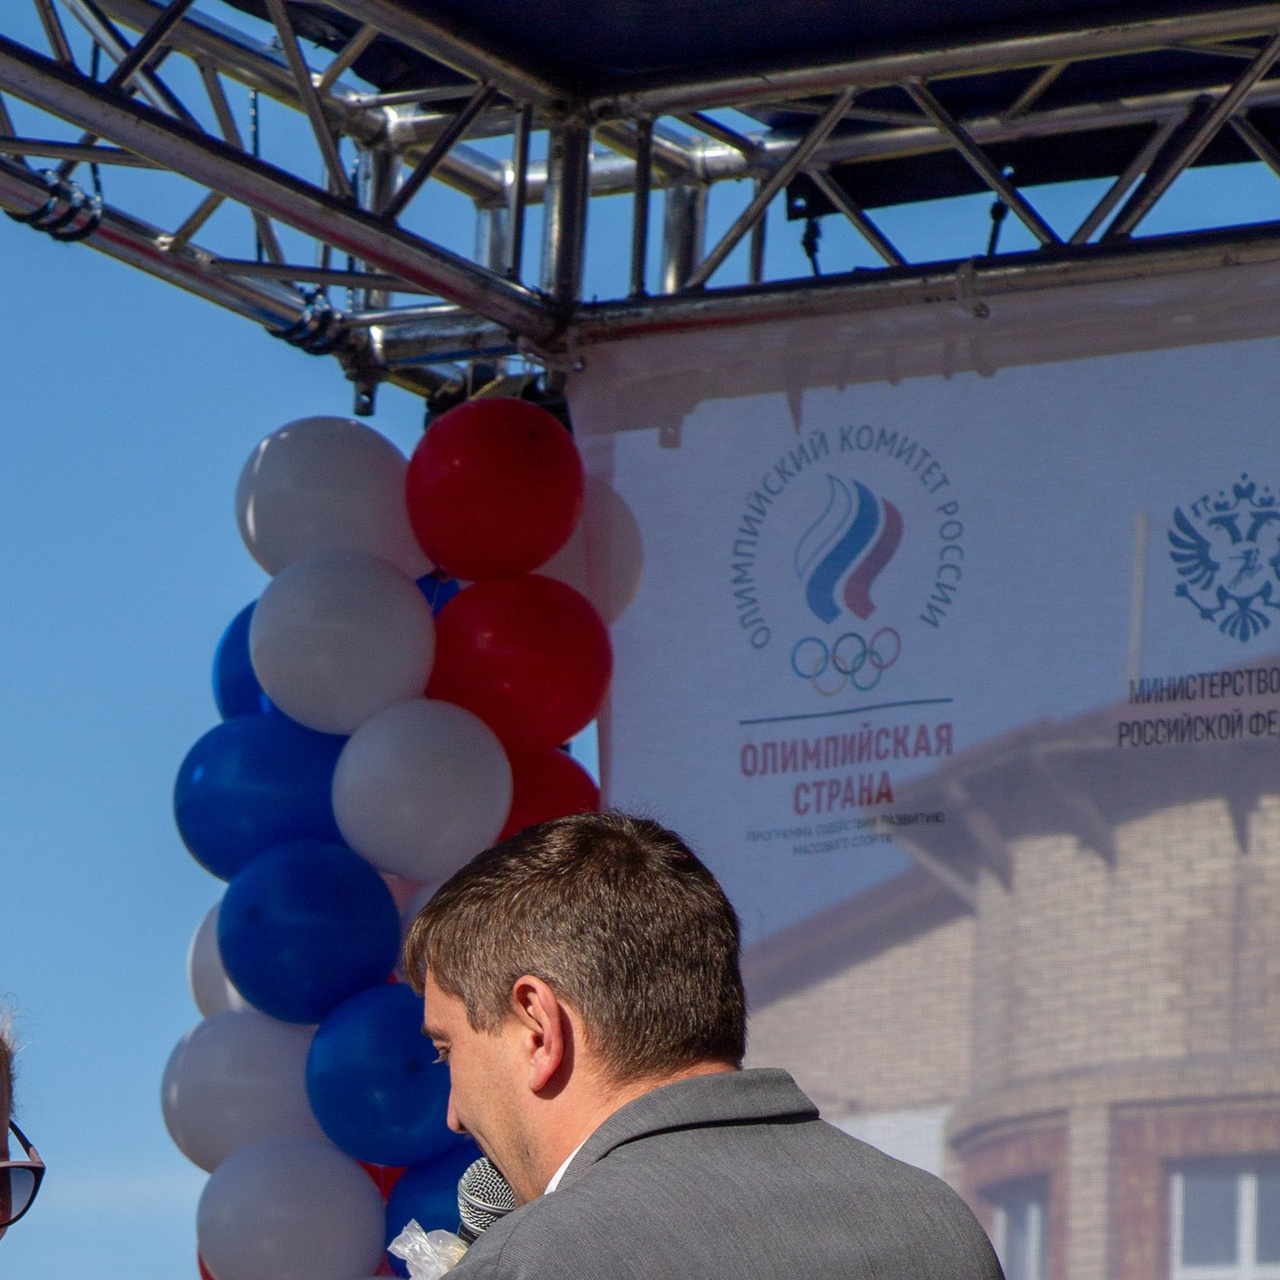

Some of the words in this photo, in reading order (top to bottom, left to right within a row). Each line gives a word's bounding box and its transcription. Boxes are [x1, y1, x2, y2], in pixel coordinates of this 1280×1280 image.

[730, 428, 830, 649] ОЛИМПИЙСКИЙ
[839, 424, 951, 495] КОМИТЕТ
[919, 499, 965, 629] РОССИИ
[1129, 666, 1280, 704] МИНИСТЕРСТВО
[1118, 708, 1244, 747] РОССИЙСКОЙ
[1248, 709, 1280, 737] ФЕ
[740, 720, 953, 777] ОЛИМПИЙСКАЯ
[793, 771, 895, 815] СТРАНА
[881, 810, 945, 826] РАЗВИТИЮ
